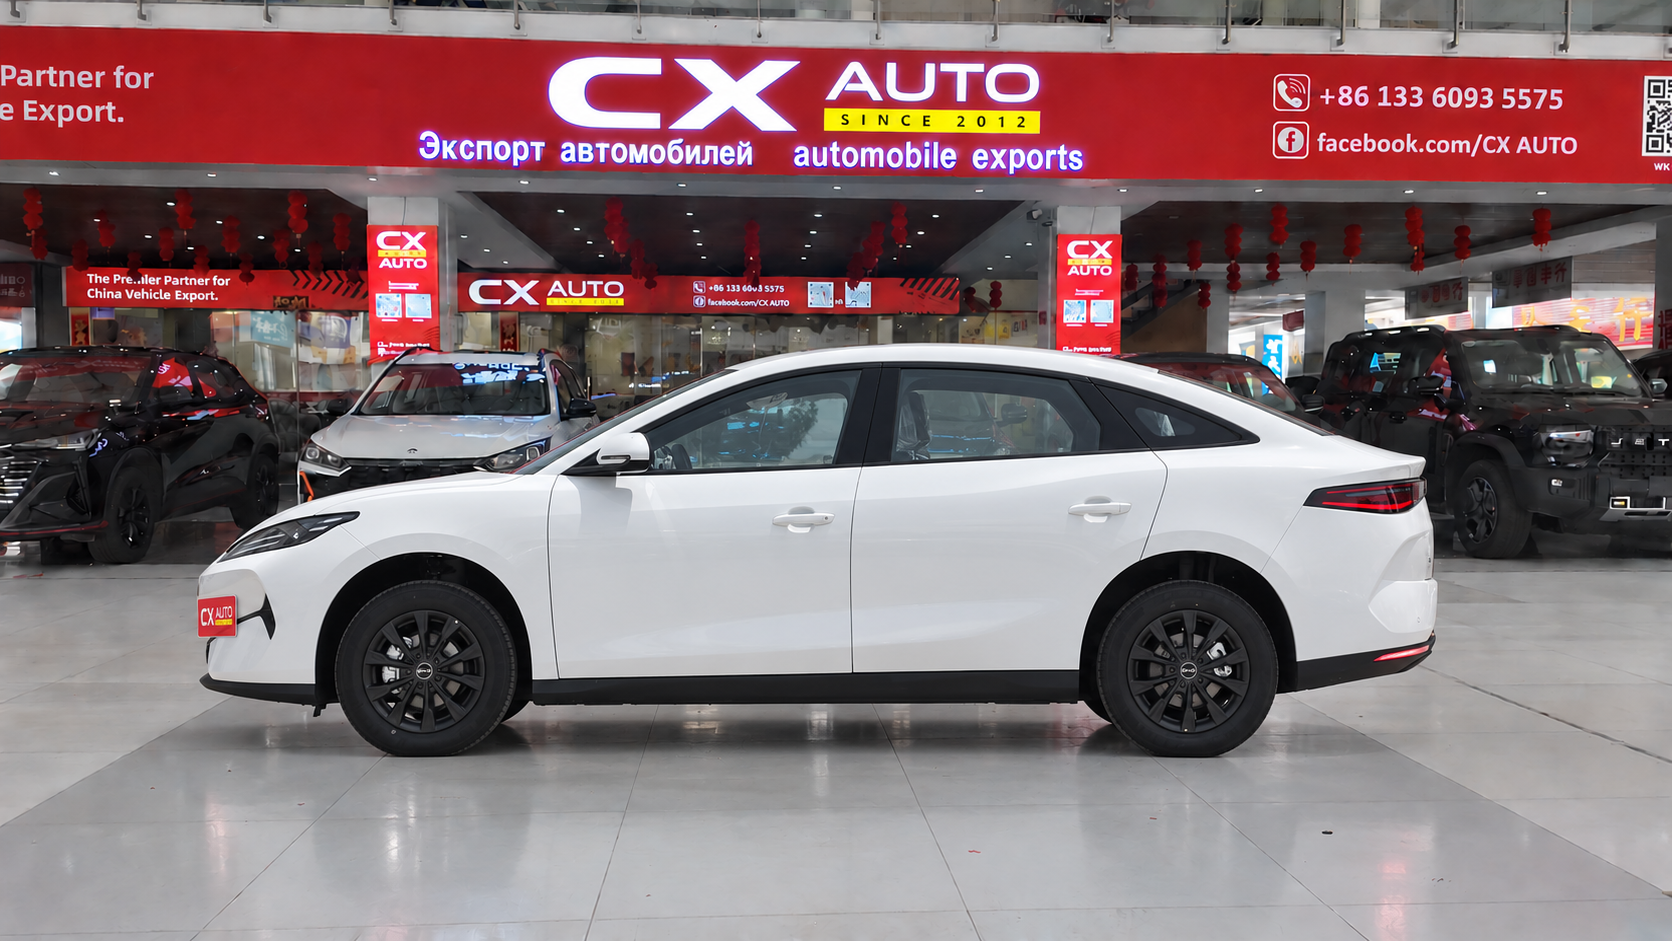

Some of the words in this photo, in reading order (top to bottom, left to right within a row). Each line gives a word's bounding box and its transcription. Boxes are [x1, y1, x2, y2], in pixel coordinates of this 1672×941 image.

[0, 65, 106, 88] Partner
[113, 65, 154, 89] for
[825, 61, 1040, 103] AUTO
[548, 56, 801, 132] CX
[1319, 85, 1369, 107] +86
[1377, 86, 1424, 108] 133
[1432, 87, 1494, 109] 6093
[1501, 88, 1563, 110] 5575
[23, 100, 124, 128] Export.
[841, 113, 931, 127] SINCE
[956, 115, 1026, 128] 2012
[419, 131, 546, 166] Экспорт
[560, 138, 753, 166] автомобилей
[1316, 133, 1510, 158] facebook.com/CX
[1515, 136, 1578, 155] AUTO
[793, 141, 957, 170] automobile
[971, 143, 1084, 174] exports
[376, 230, 427, 250] CX
[1066, 240, 1113, 259] CX
[378, 257, 428, 269] AUTO
[1067, 265, 1113, 276] AUTO
[86, 273, 110, 284] The
[164, 275, 211, 286] Partner
[212, 275, 231, 286] for
[547, 280, 624, 297] AUTO
[86, 288, 122, 299] China
[125, 288, 171, 300] Vehicle
[174, 290, 219, 303] Export.
[468, 279, 540, 306] CX
[769, 299, 790, 307] AUTO
[201, 608, 214, 626] CX
[215, 606, 233, 618] AUTO
